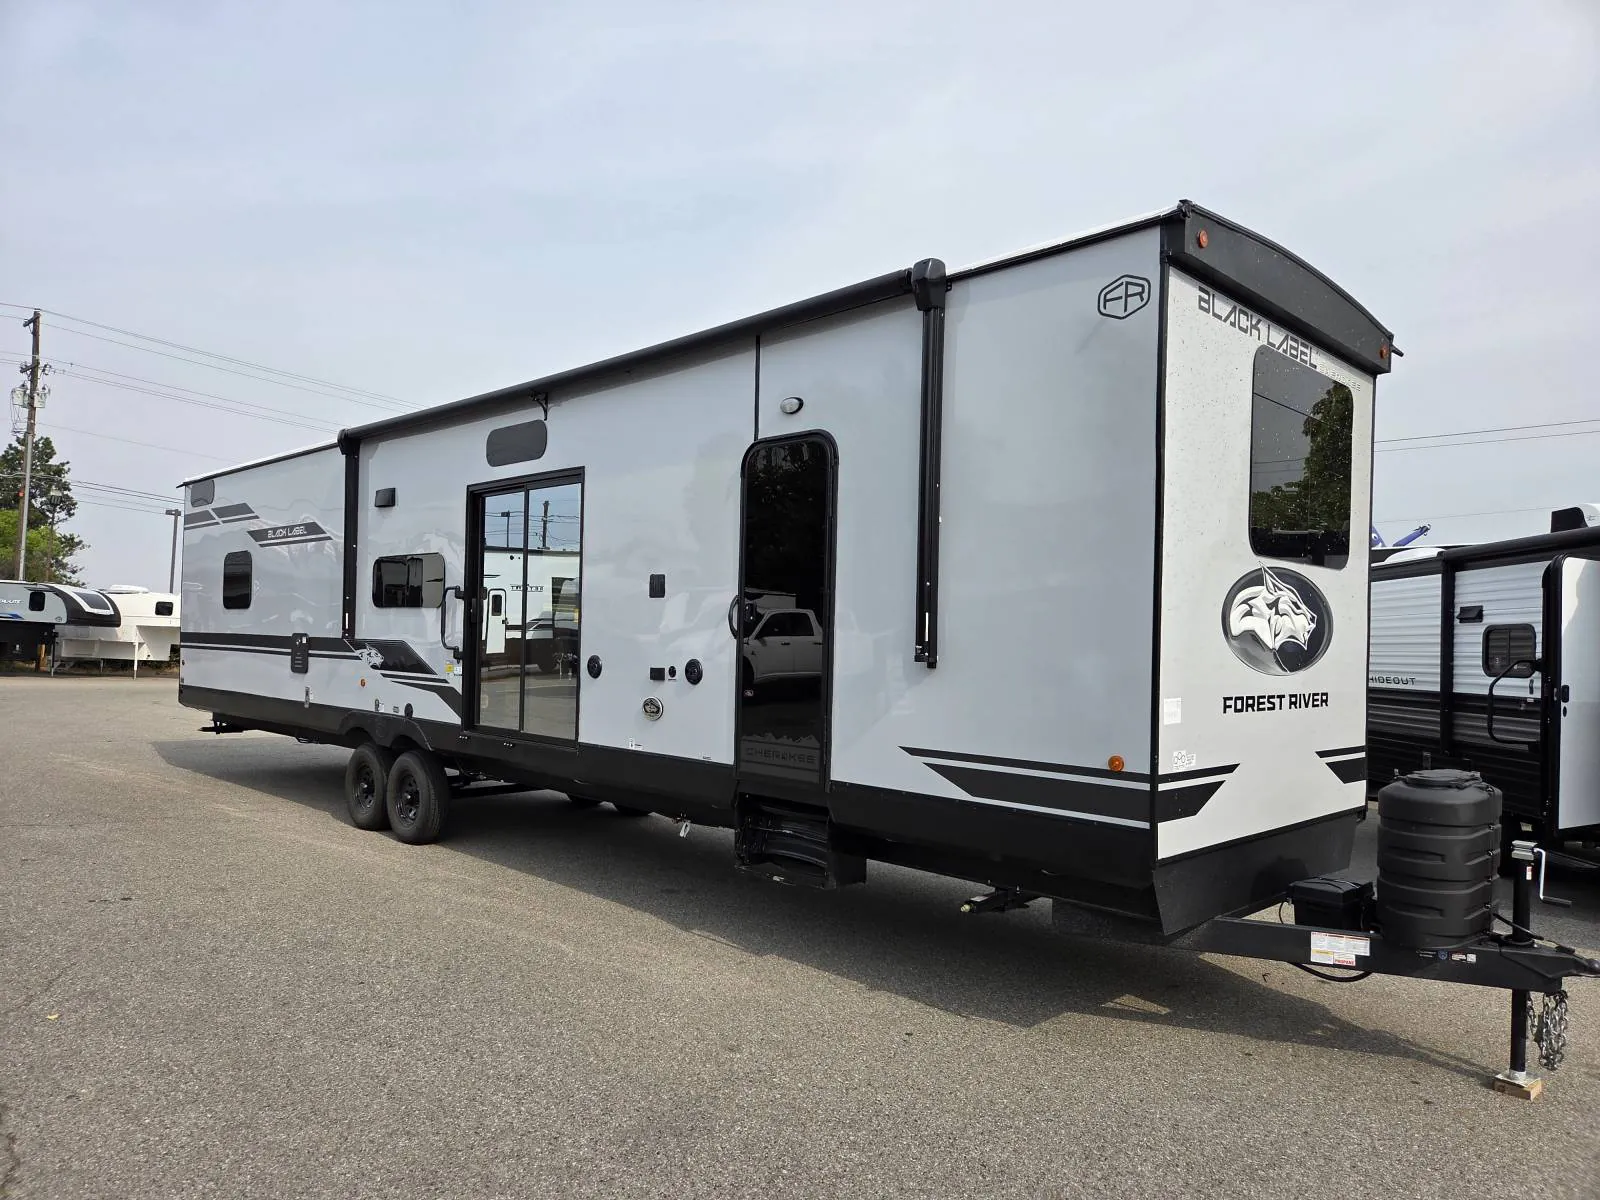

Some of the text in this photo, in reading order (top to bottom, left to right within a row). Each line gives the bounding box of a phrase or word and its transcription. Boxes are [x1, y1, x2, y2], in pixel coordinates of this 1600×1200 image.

[1102, 280, 1146, 313] FR
[1197, 285, 1317, 370] BLACK LABEL
[267, 525, 307, 539] BLACK LABEL
[1222, 692, 1330, 715] FOREST RIVER
[745, 746, 818, 765] CHEROKEE
